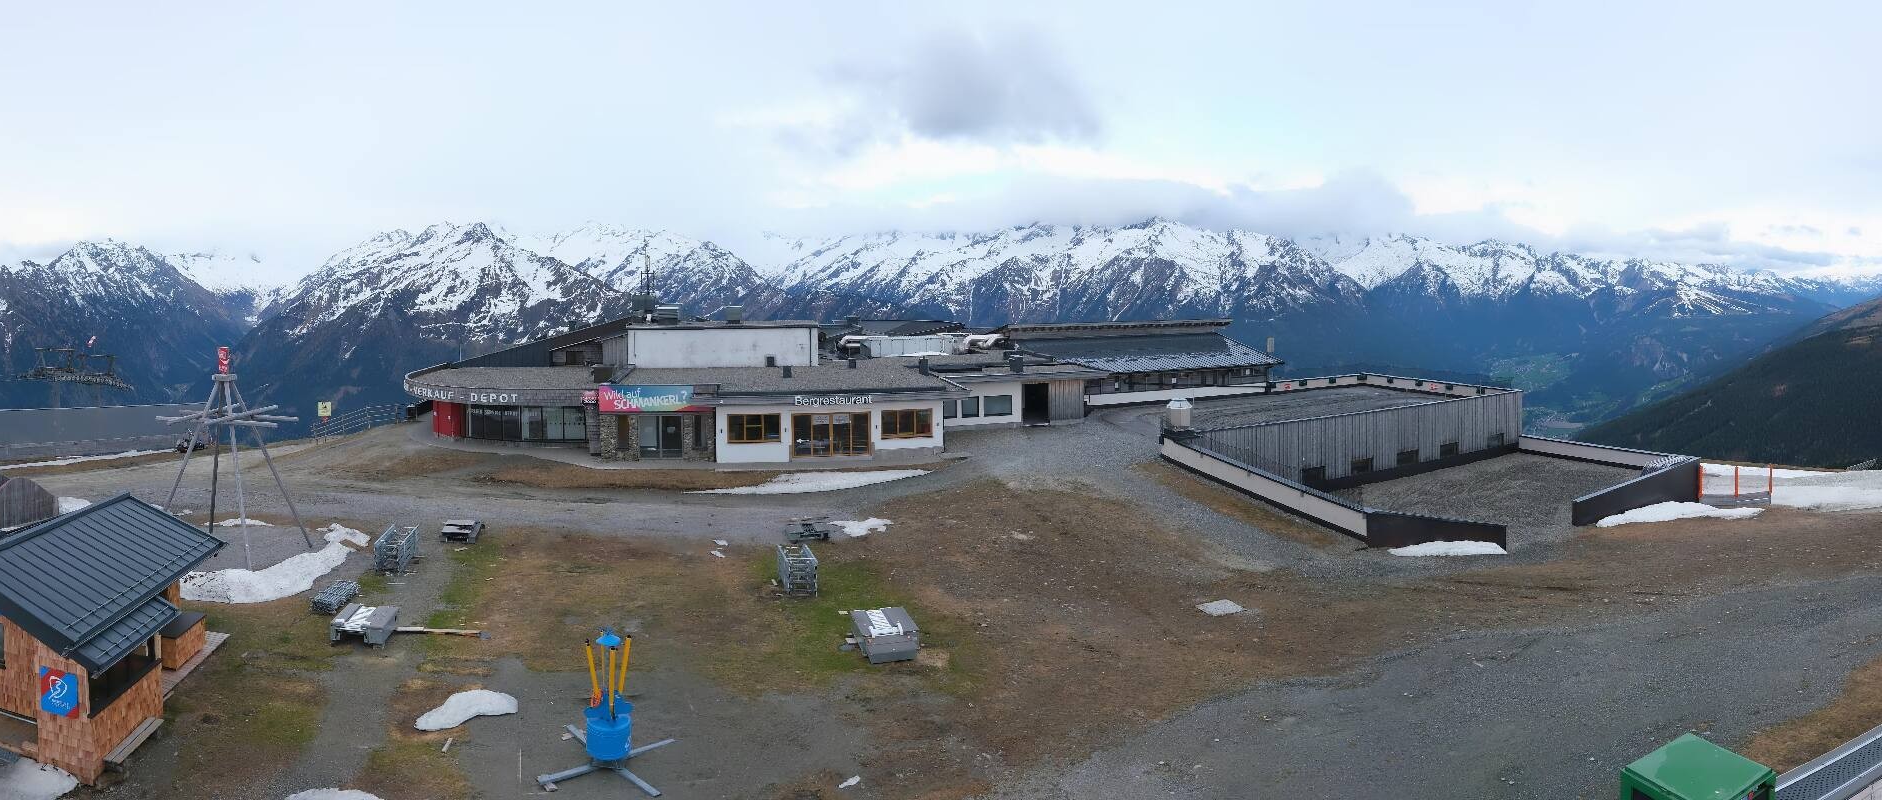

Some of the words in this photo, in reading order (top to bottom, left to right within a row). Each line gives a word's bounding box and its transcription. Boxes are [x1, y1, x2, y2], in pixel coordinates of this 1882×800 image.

[414, 386, 454, 399] VERKAUF
[470, 393, 518, 402] DEPOT
[604, 389, 624, 401] Wild
[626, 387, 641, 399] auf
[613, 390, 688, 410] SCHMANKERL?
[794, 395, 873, 407] Bergrestaurant
